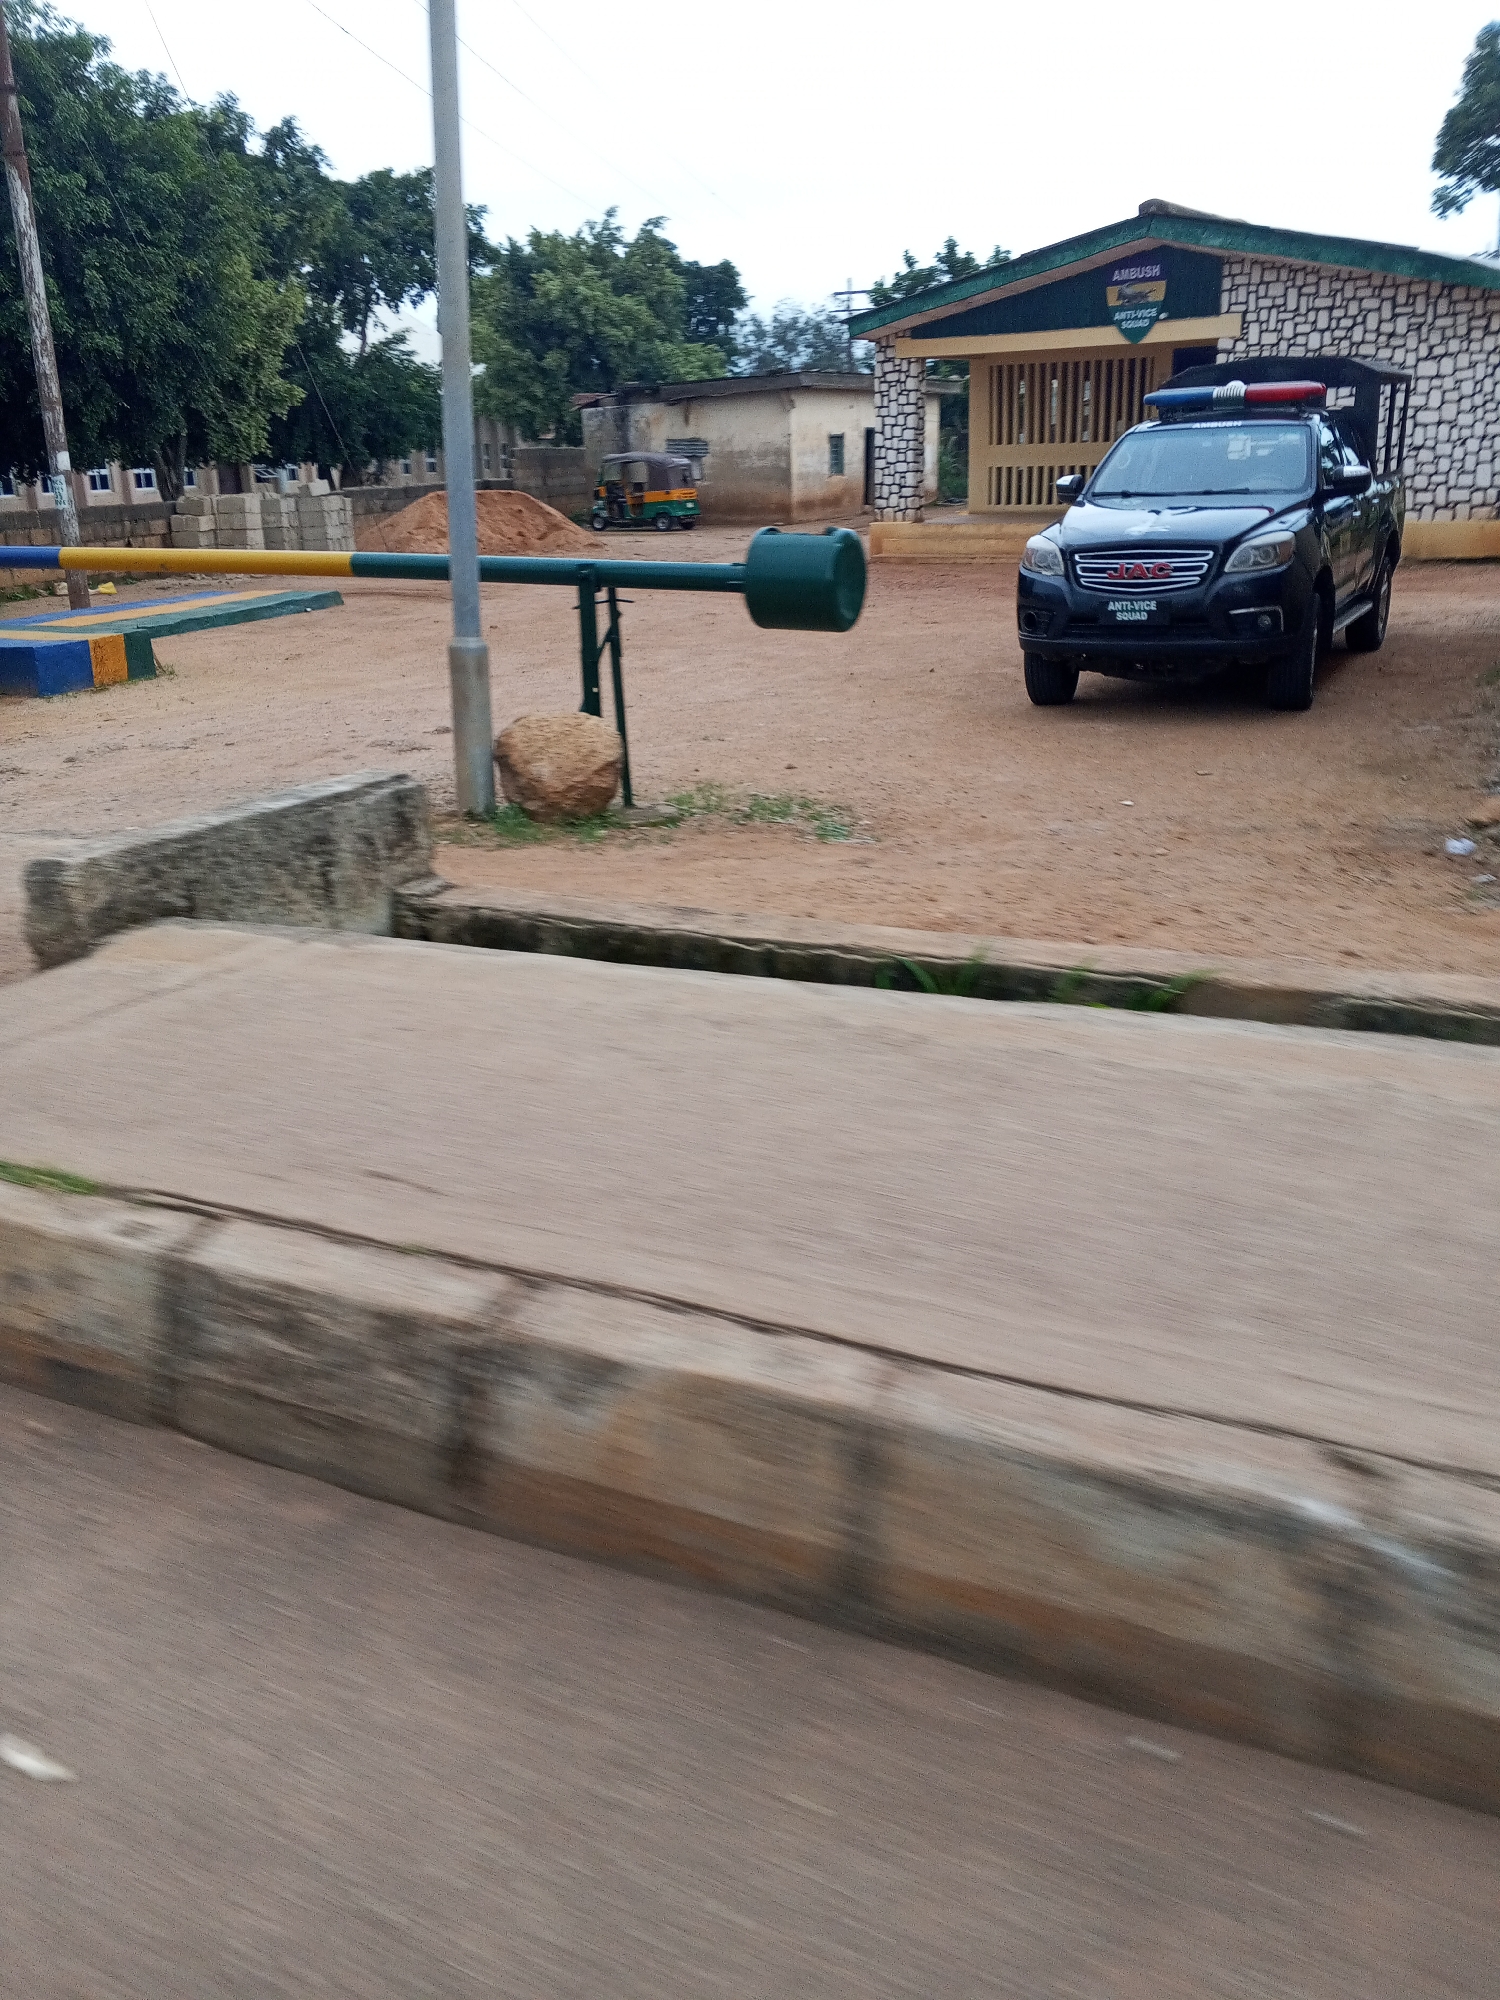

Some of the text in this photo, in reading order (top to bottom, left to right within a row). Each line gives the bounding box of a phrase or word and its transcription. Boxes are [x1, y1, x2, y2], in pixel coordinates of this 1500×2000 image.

[1112, 265, 1160, 281] AMBUSH
[1114, 308, 1157, 320] ANTI-VICE
[1121, 319, 1149, 329] SQUAD
[1107, 563, 1173, 579] JAC
[1108, 601, 1157, 611] ANTI-VICE
[1116, 611, 1148, 620] SQUAD
